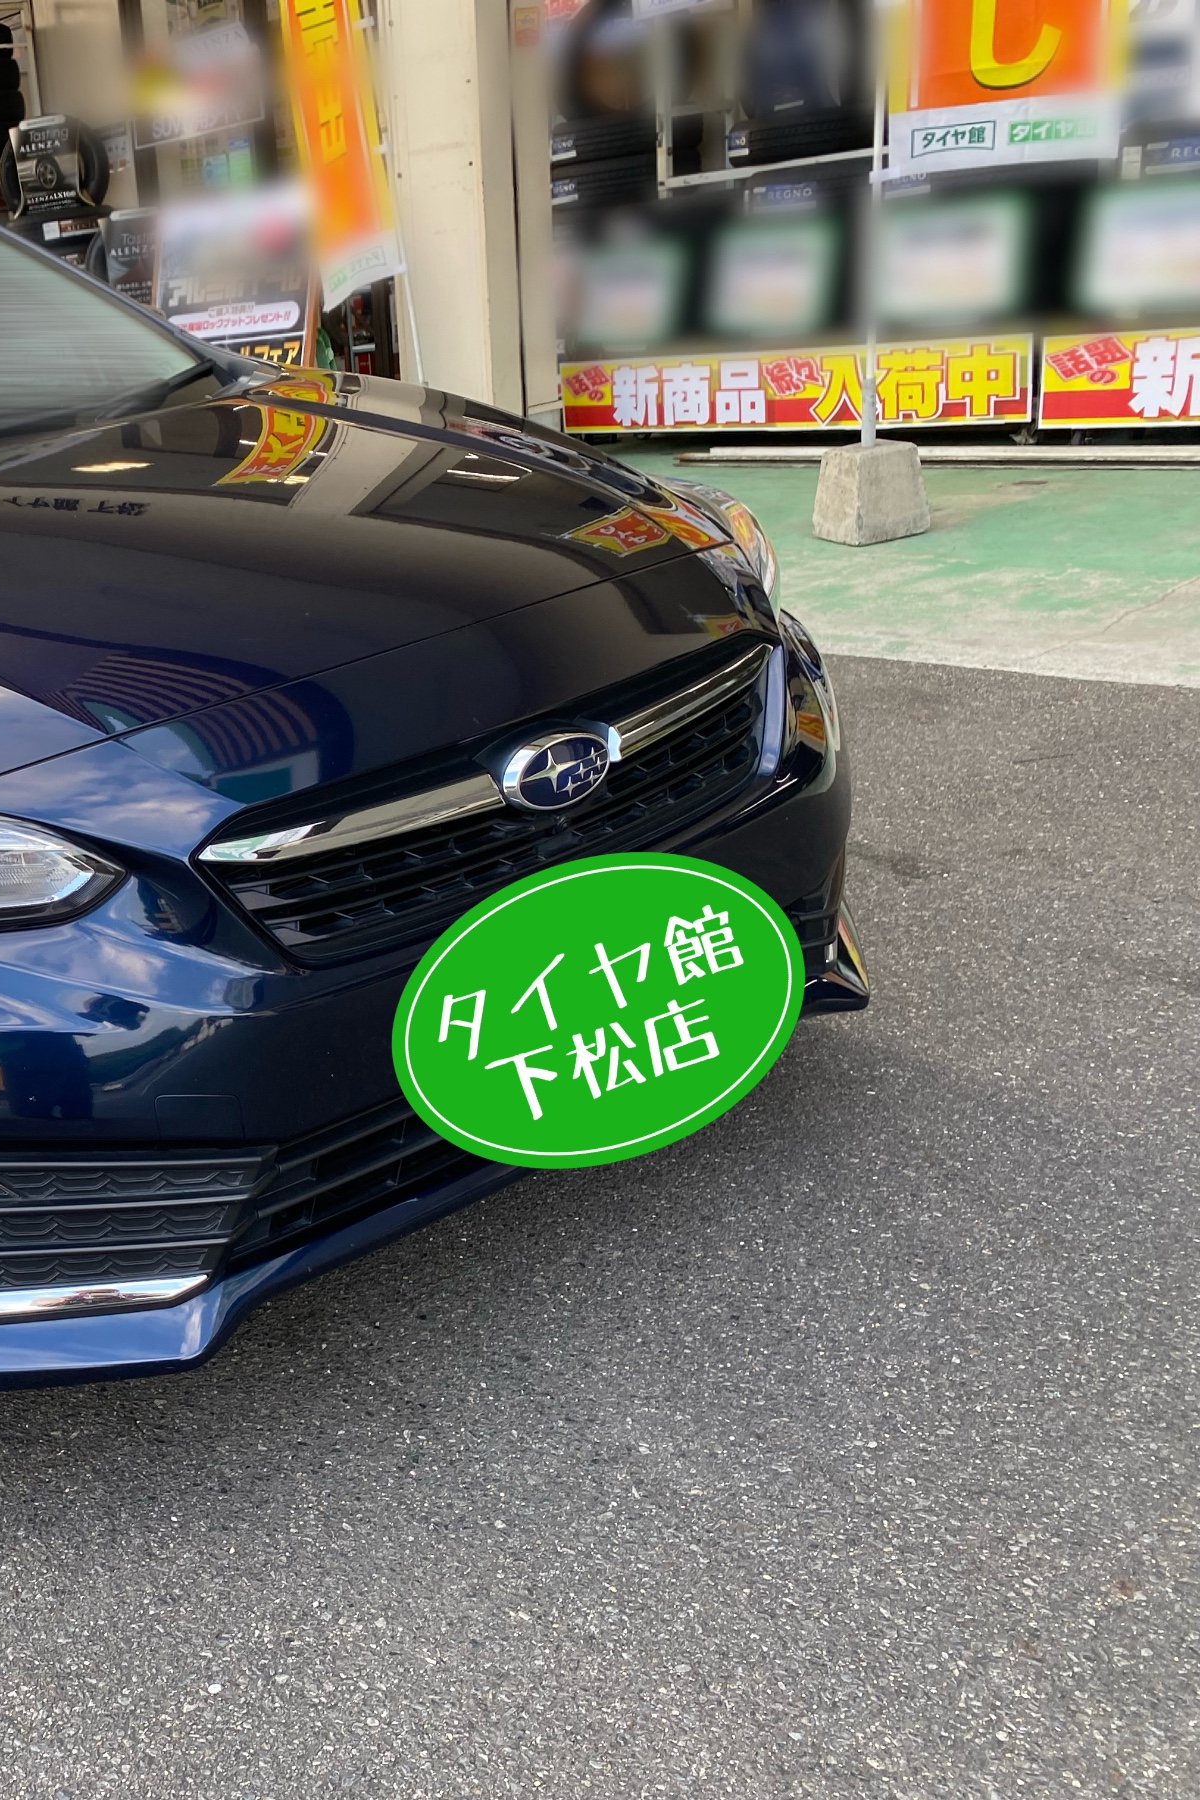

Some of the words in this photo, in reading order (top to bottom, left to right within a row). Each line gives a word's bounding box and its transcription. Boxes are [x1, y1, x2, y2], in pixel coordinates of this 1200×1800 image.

[20, 140, 60, 153] ALENZA
[29, 128, 69, 142] Tasting
[921, 125, 987, 149] タイヤ館
[767, 186, 813, 201] REGNO
[1046, 335, 1134, 386] 話題の
[564, 364, 611, 402] 話題の
[612, 360, 767, 427] 新商品
[810, 344, 1020, 426] 入荷中
